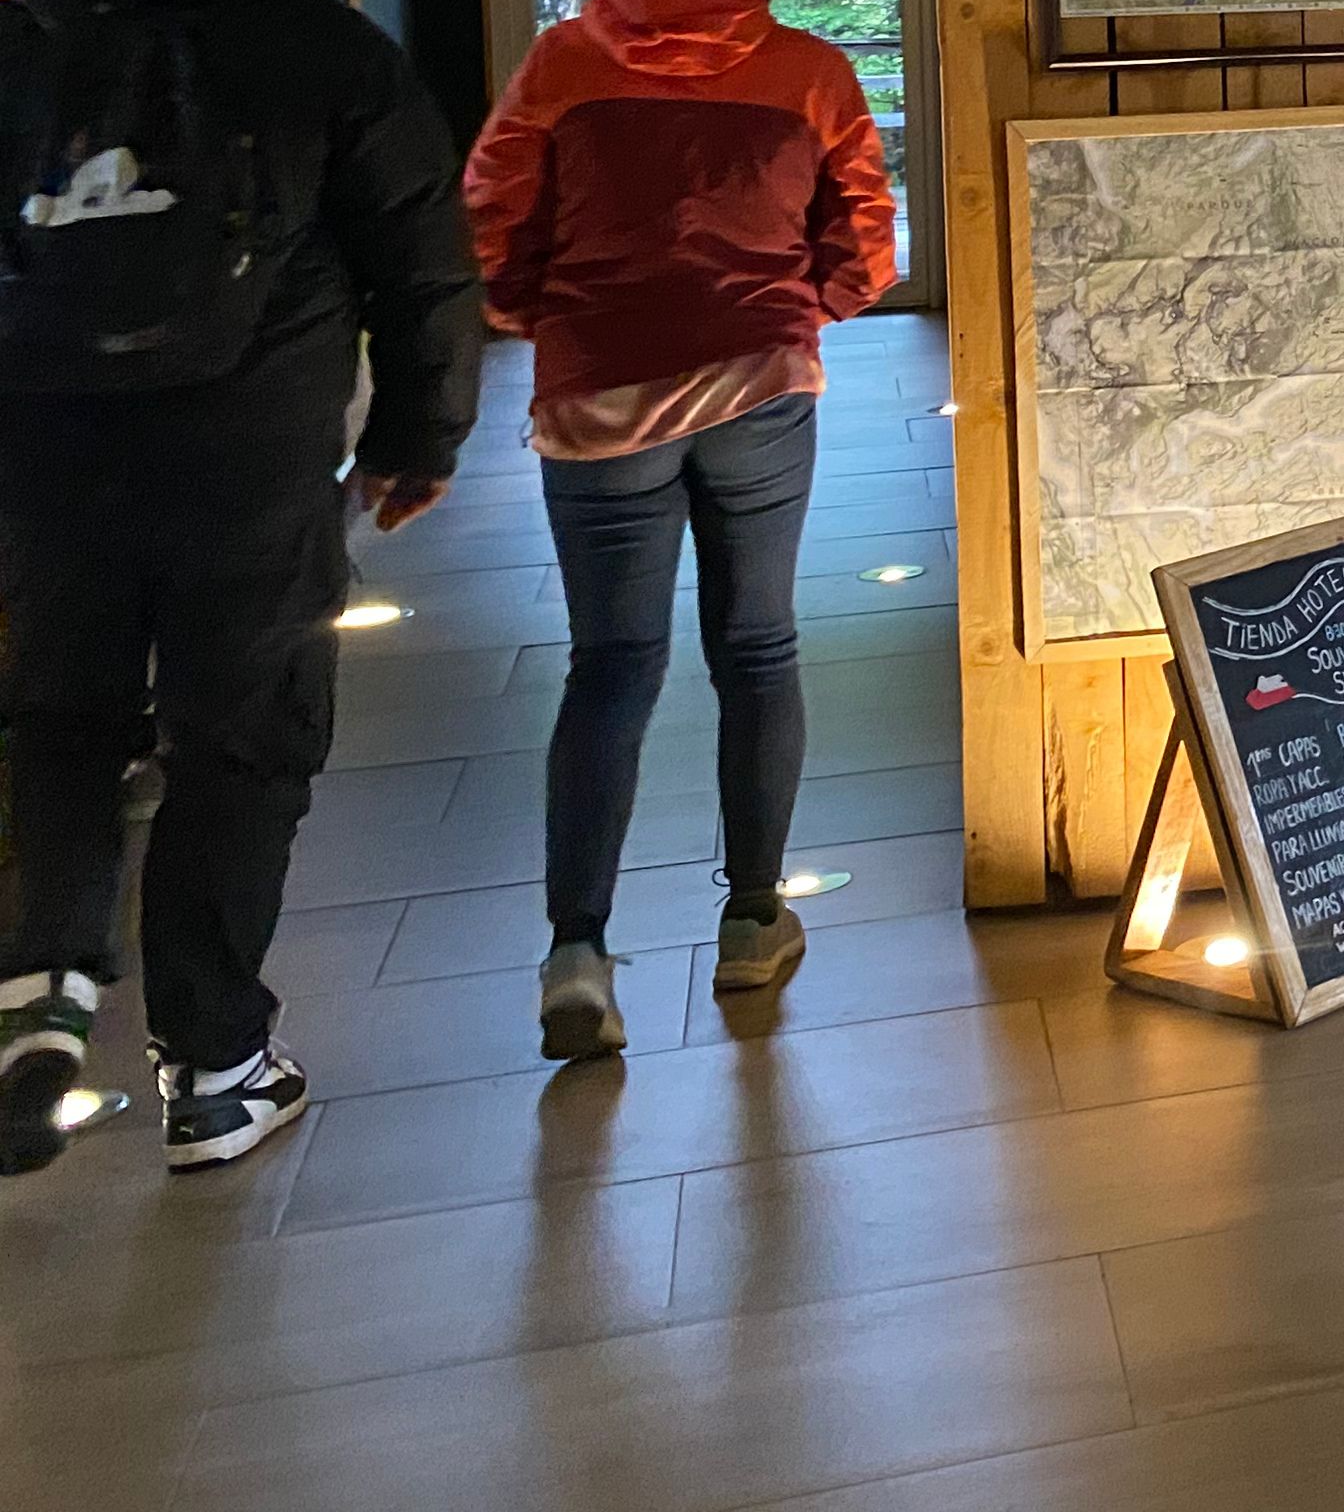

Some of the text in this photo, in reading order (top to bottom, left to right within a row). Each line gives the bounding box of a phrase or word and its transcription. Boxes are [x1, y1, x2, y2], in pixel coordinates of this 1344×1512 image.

[1278, 736, 1321, 767] CAPAS
[1253, 776, 1290, 807] ROPA
[1286, 774, 1297, 795] Y
[1271, 834, 1310, 865] PARA
[1291, 892, 1342, 930] MAPAS
